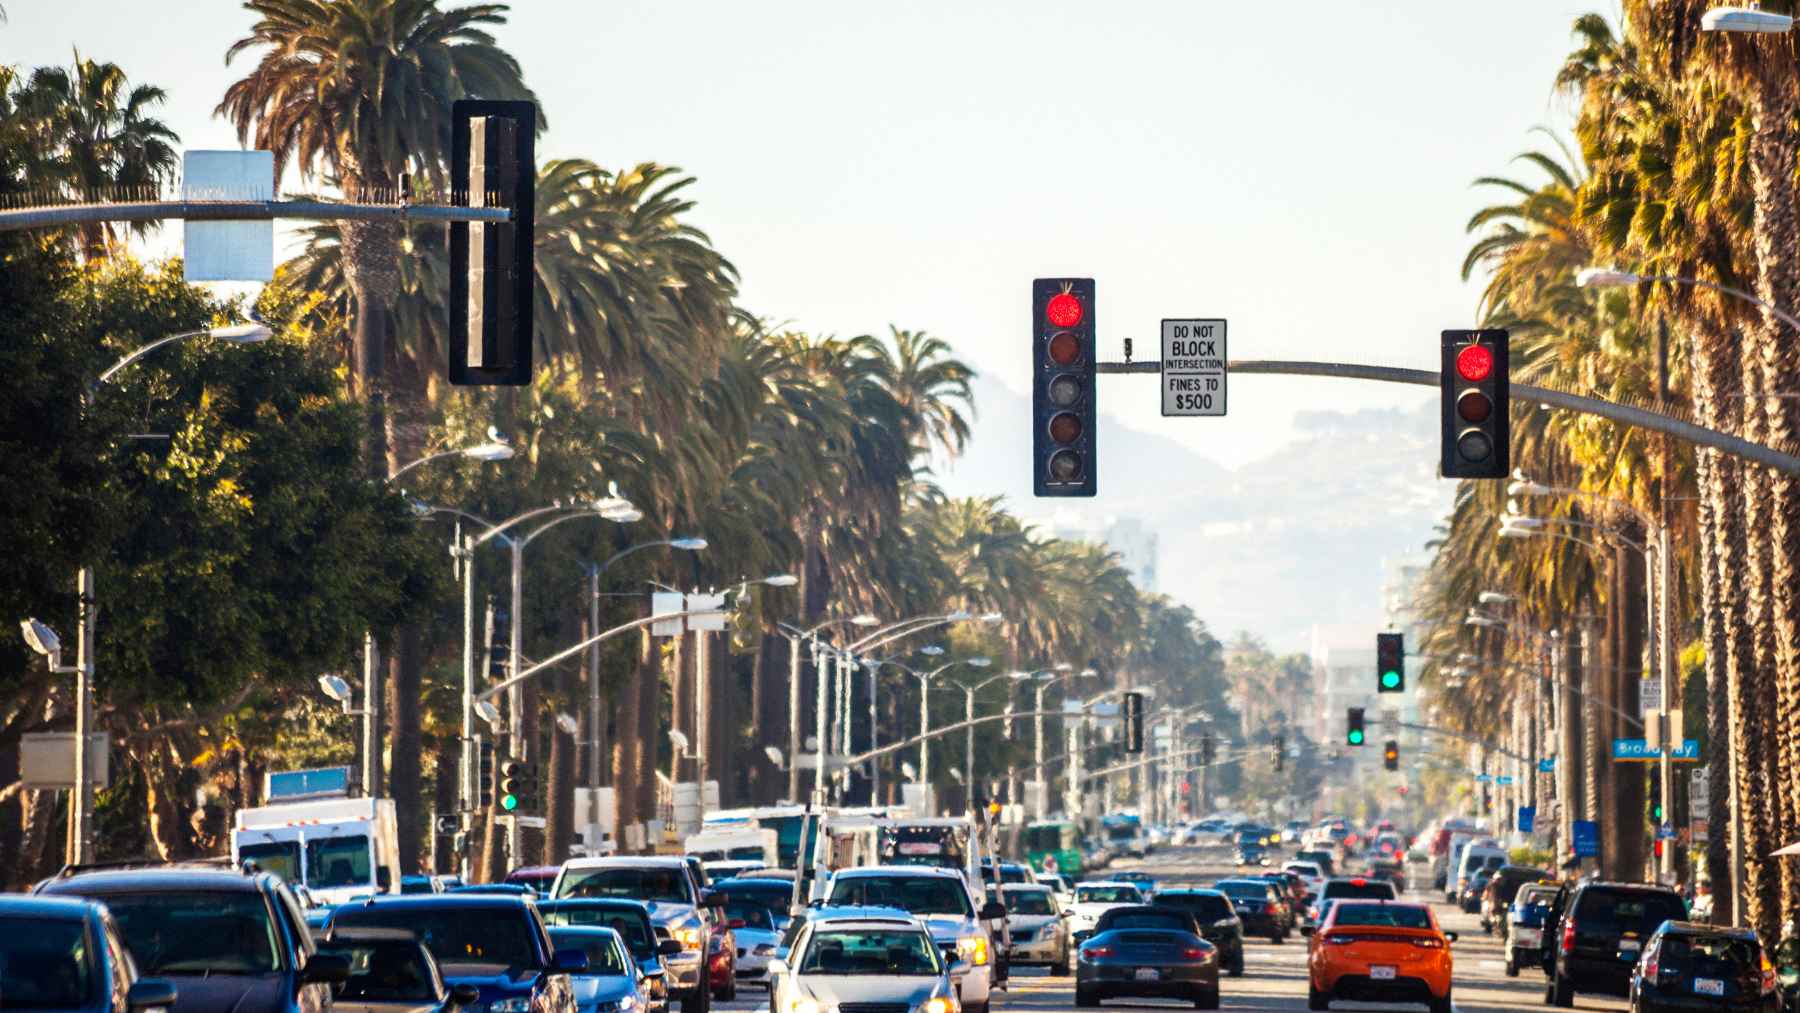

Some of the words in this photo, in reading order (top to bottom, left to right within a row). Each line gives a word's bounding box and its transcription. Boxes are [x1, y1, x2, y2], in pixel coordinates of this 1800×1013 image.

[1174, 326, 1188, 338] DO
[1193, 326, 1214, 338] NOT
[1172, 341, 1215, 356] BLOCK
[1166, 360, 1223, 369] INTERSECTION
[1170, 379, 1201, 391] FINES
[1206, 379, 1218, 391] TO
[1176, 394, 1212, 410] $500
[1618, 742, 1693, 757] Broaday
